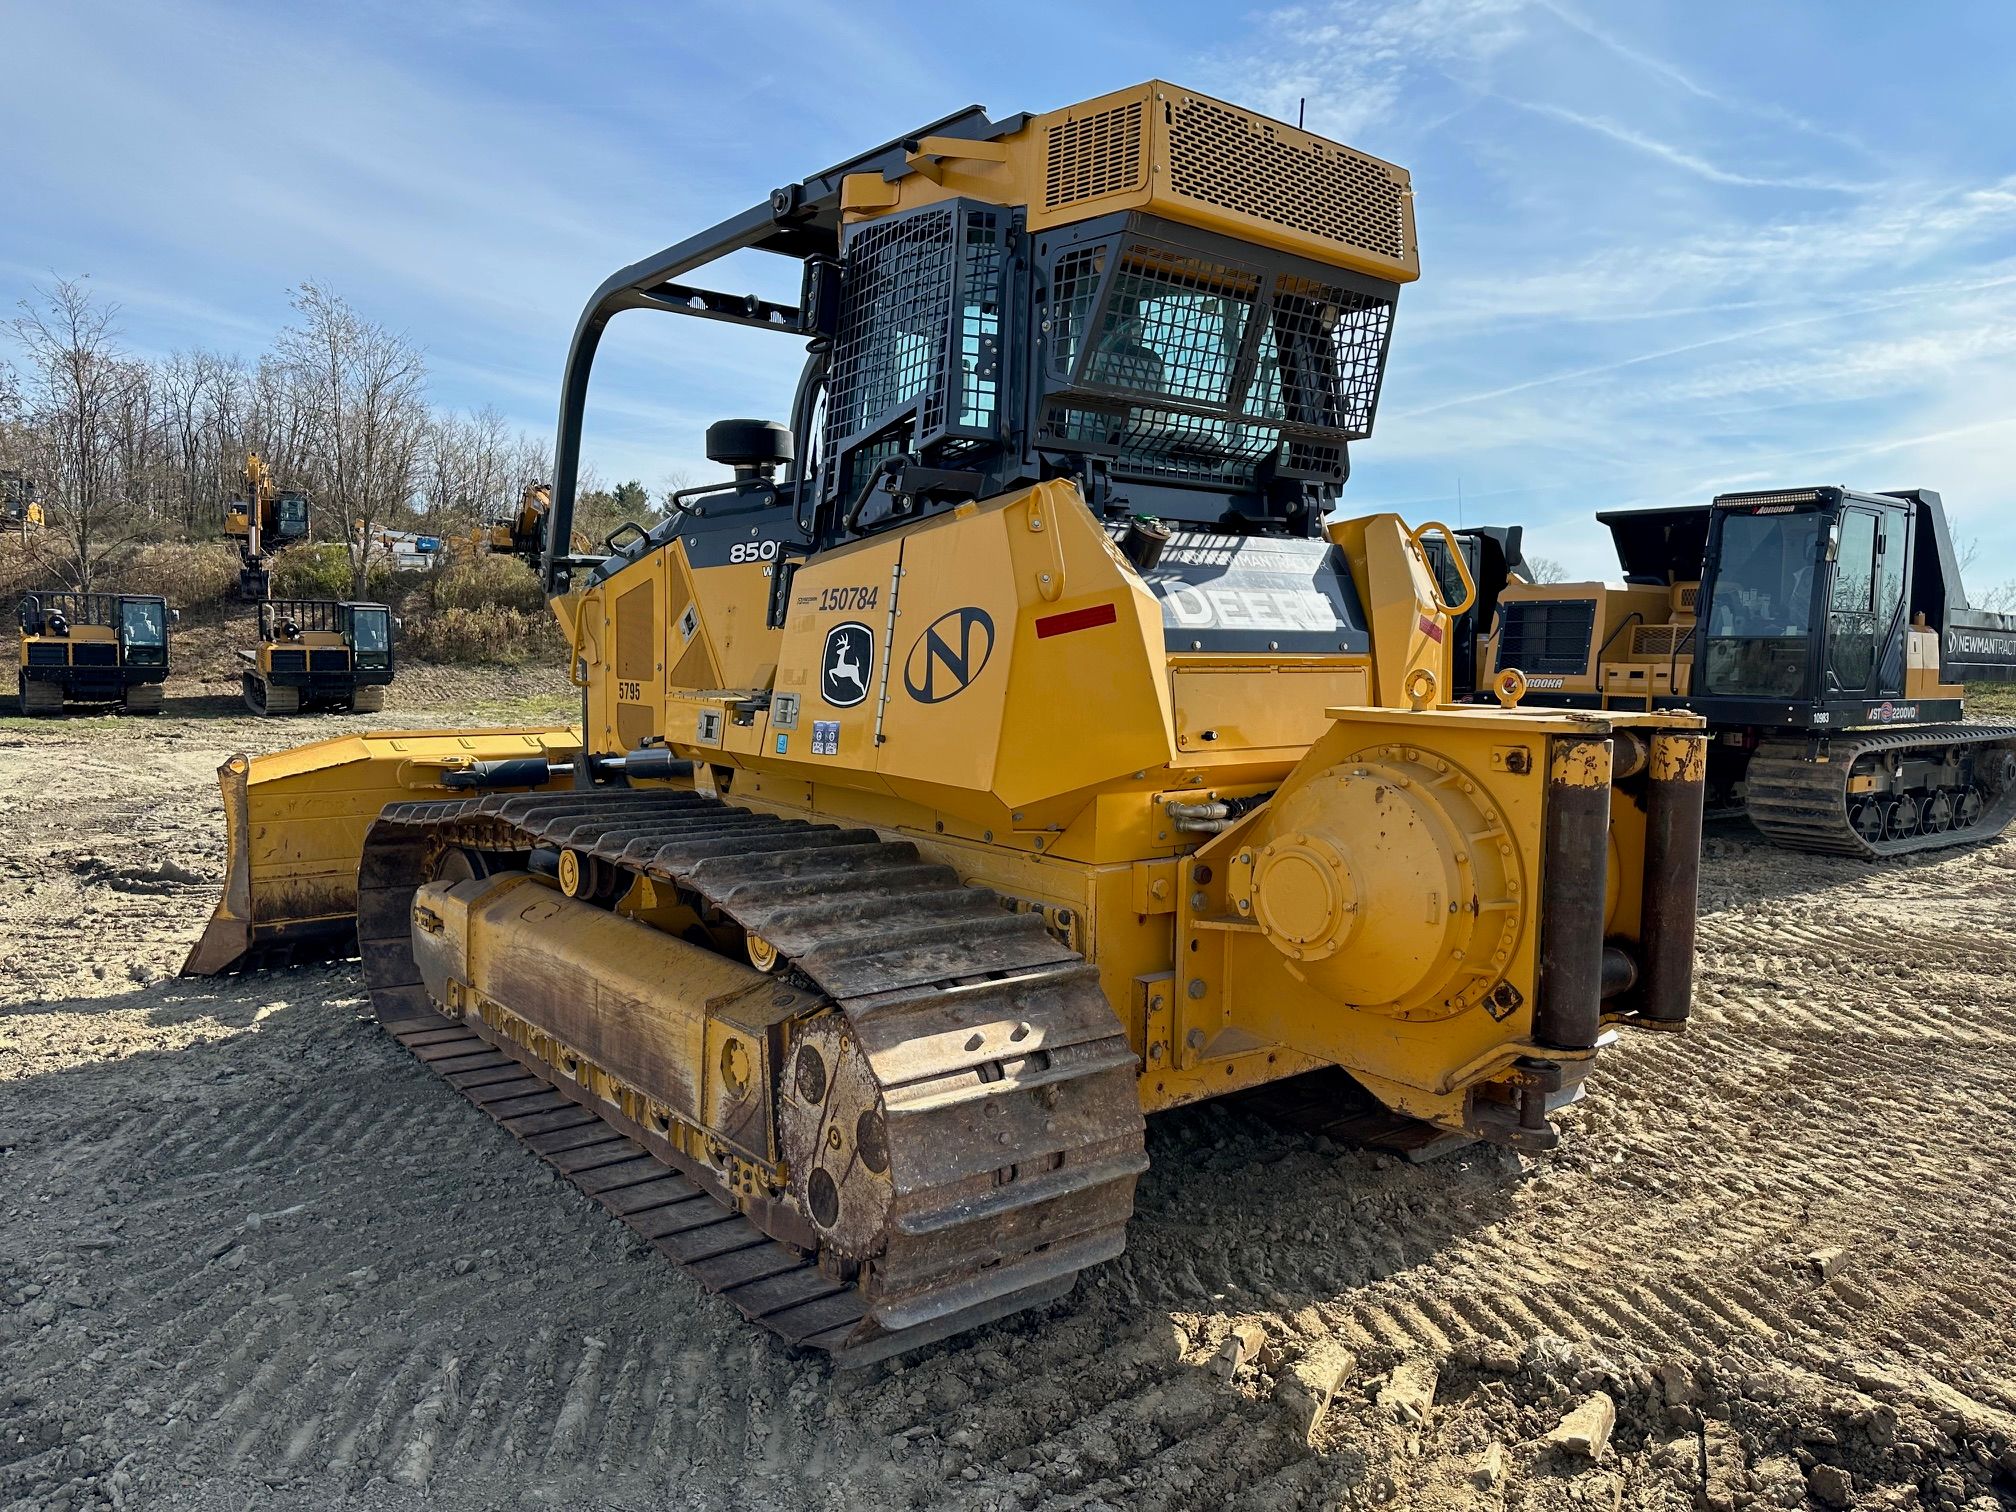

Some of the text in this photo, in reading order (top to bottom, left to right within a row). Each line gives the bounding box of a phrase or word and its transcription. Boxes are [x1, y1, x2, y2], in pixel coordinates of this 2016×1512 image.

[818, 586, 879, 611] 150784
[1161, 580, 1346, 629] DEERE
[619, 682, 640, 701] 5795
[1813, 712, 1830, 724] 10983
